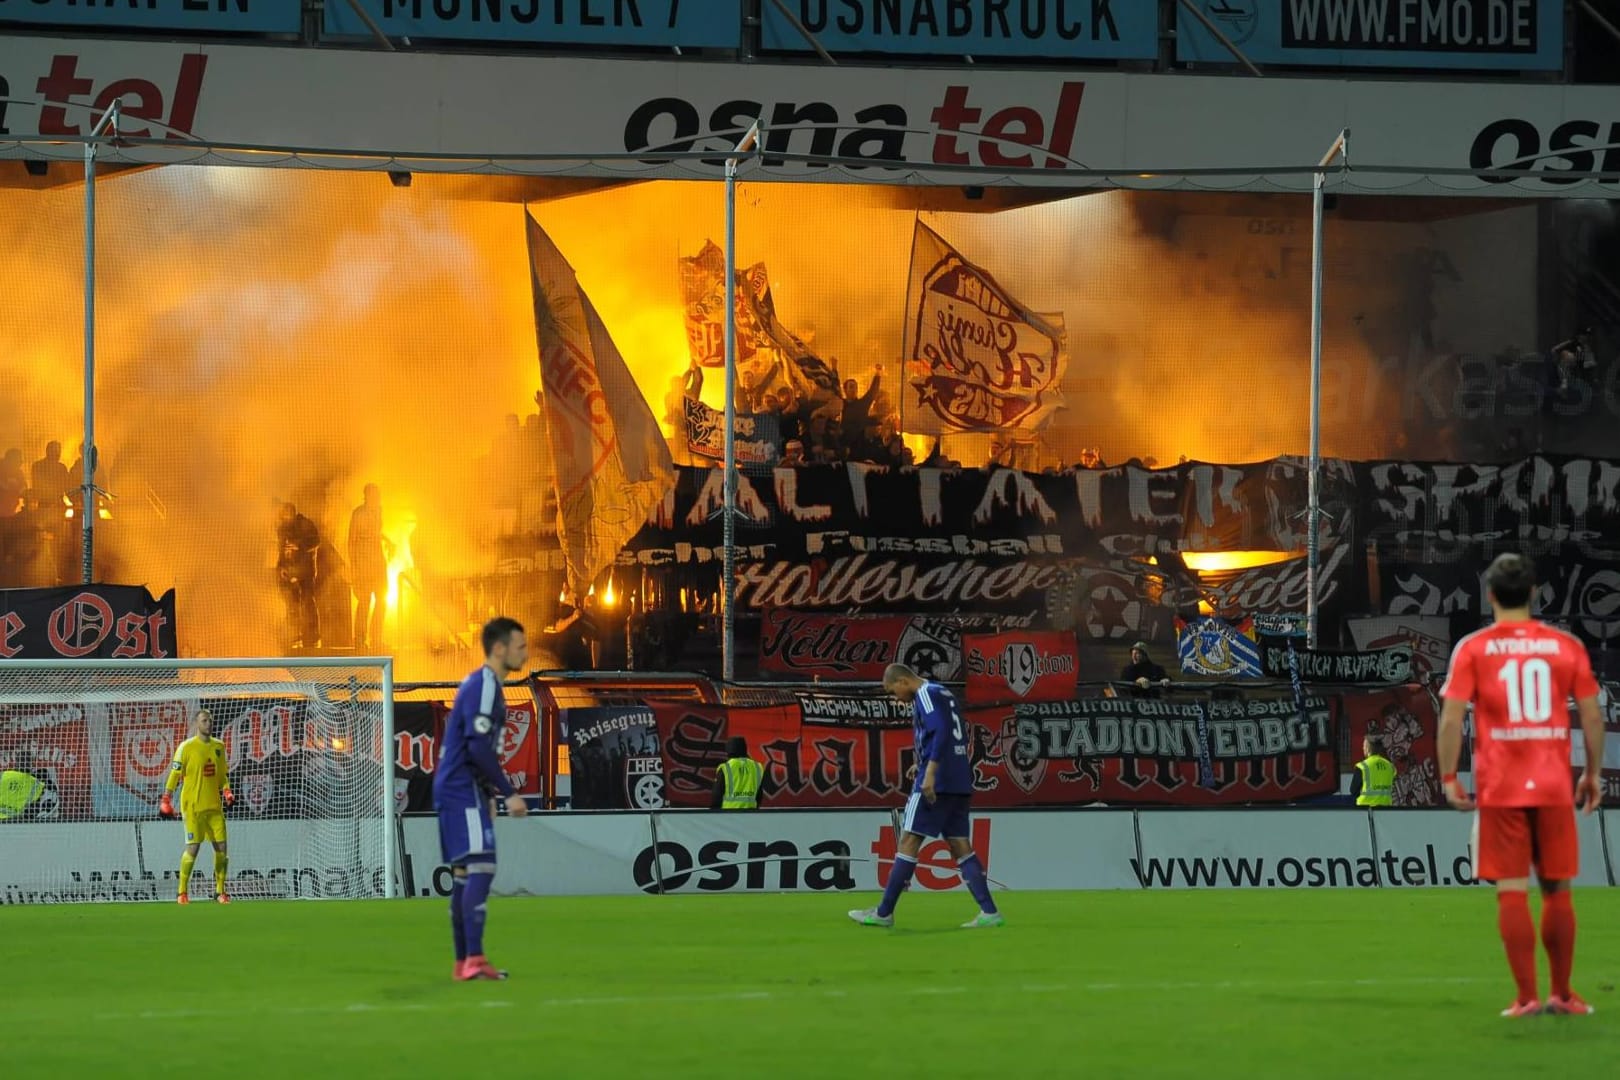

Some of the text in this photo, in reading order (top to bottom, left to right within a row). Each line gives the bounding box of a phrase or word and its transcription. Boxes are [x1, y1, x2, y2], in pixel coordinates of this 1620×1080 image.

[1290, 0, 1531, 47] WWW.FMO.DE
[0, 53, 208, 148] tel
[624, 81, 1086, 171] osnatel
[1469, 118, 1620, 187] os
[47, 592, 170, 658] Ost
[803, 694, 889, 719] DURCHHALTEN
[1497, 657, 1552, 723] 10
[634, 759, 664, 774] HFC
[666, 714, 913, 806] Saal
[633, 817, 993, 894] osnatel
[1130, 843, 1500, 887] www.osnatel.d
